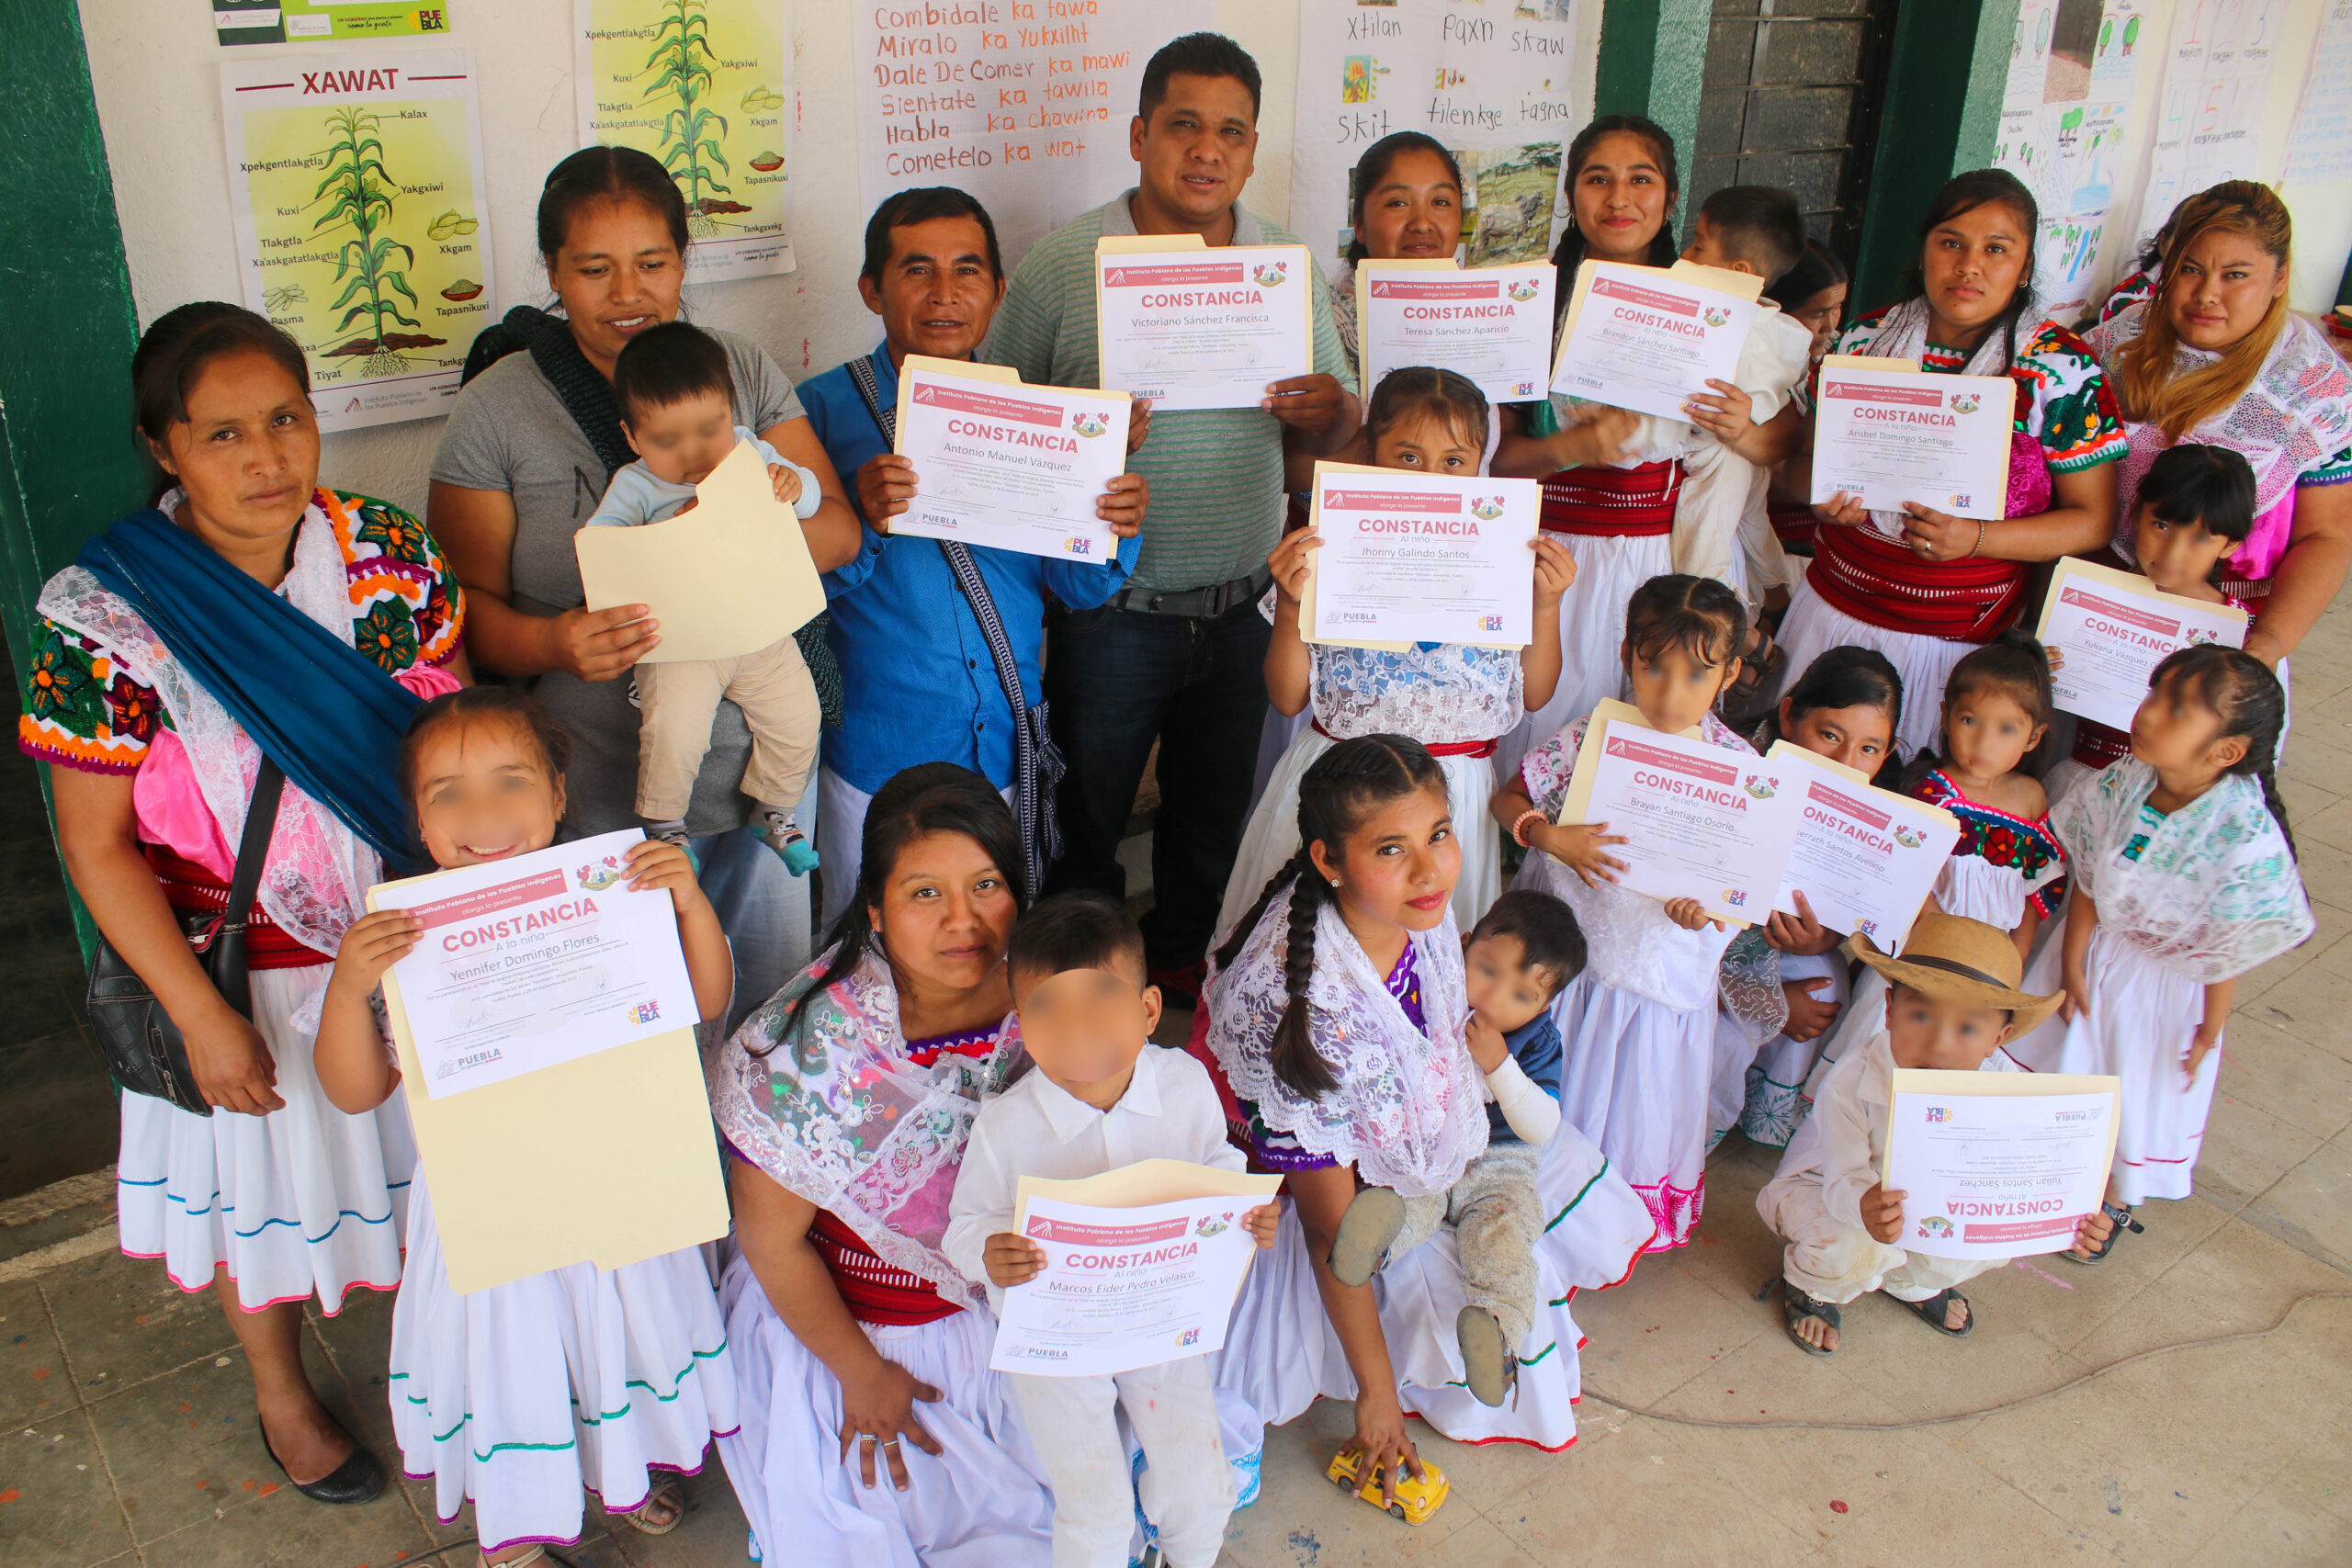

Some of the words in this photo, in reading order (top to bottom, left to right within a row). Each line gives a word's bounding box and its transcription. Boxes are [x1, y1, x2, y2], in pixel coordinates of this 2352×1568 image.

[419, 10, 441, 19] PUE
[876, 1, 1000, 29] Combidale
[1012, 2, 1035, 20] ka
[422, 19, 443, 29] BLA
[2184, 1, 2202, 45] 1
[585, 28, 655, 40] Xpekgentlakgtla
[877, 33, 956, 58] Miralo
[982, 30, 1008, 51] ka
[720, 59, 758, 70] Yakgxiwi
[613, 73, 632, 83] Kuxi
[874, 61, 926, 87] Dale
[934, 61, 964, 83] De
[970, 60, 1035, 81] Comer
[1048, 57, 1073, 77] ka
[302, 68, 399, 95] XAWAT
[882, 89, 977, 116] Sientate
[1000, 88, 1028, 108] ka
[1044, 79, 1108, 102] tawila
[400, 110, 427, 119] Kalax
[598, 102, 633, 114] Tlakgtla
[2202, 85, 2224, 131] 5
[750, 118, 777, 127] Xkgam
[887, 115, 950, 145] Habla
[987, 113, 1016, 133] ka
[240, 157, 323, 173] Xpekgentlakgtla
[887, 146, 992, 176] Cometelo
[1004, 142, 1031, 164] ka
[744, 174, 788, 186] Tapasnikuxi
[401, 182, 444, 196] Yakgxiwi
[277, 206, 300, 216] Kuxi
[261, 237, 302, 248] Tlakgtla
[439, 243, 472, 254] Xkgam
[1141, 290, 1263, 308] CONSTANCIA
[435, 301, 489, 317] Tapasnikuxi
[1404, 305, 1515, 320] CONSTANCIA
[1132, 317, 1181, 328] Victoriano
[1183, 315, 1223, 325] Sánchez
[1614, 307, 1704, 338] CONSTANCIA
[1405, 327, 1432, 336] Teresa
[1474, 324, 1510, 334] Aparicio
[1602, 328, 1634, 342] Brandon
[1668, 344, 1700, 359] Santiago
[438, 357, 467, 367] Tankga
[314, 370, 342, 381] Tiyat
[1853, 407, 1956, 426] CONSTANCIA
[948, 419, 1079, 454] CONSTANCIA
[1879, 432, 1916, 443] Domingo
[1918, 435, 1953, 446] Santiago
[944, 443, 985, 457] Antonio
[988, 449, 1027, 465] Manuel
[1838, 483, 1865, 491] PUEBLA
[922, 514, 956, 525] PUEBLA
[1359, 519, 1479, 536] CONSTANCIA
[1074, 538, 1091, 547] PUE
[1072, 545, 1089, 555] BLA
[1362, 547, 1396, 558] Jhonny
[1398, 548, 1435, 558] Galindo
[1438, 550, 1470, 559] Santos
[1343, 613, 1376, 621] PUEBLA
[1487, 616, 1503, 625] PUE
[1487, 623, 1502, 631] BLA
[2085, 617, 2184, 653] CONSTANCI
[2085, 639, 2112, 654] Yuliana
[1634, 772, 1747, 811] CONSTANCIA
[1630, 796, 1661, 813] Brayan
[1664, 806, 1702, 824] Santiago
[1804, 807, 1894, 854] ONSTANCIA
[1826, 840, 1853, 858] Santos
[1855, 854, 1884, 872] Avelino
[415, 904, 446, 917] Instituto
[447, 896, 475, 908] Poblano
[477, 893, 486, 901] de
[487, 890, 497, 898] los
[499, 883, 526, 894] Pueblos
[443, 897, 599, 952] CONSTANCIA
[496, 942, 504, 952] A
[506, 938, 517, 949] la
[449, 960, 502, 982] Yennifer
[505, 944, 560, 967] Domingo
[563, 932, 600, 951] Flores
[638, 1001, 659, 1014] PUE
[639, 1010, 661, 1024] BLA
[458, 1048, 502, 1066] PUEBLA
[2003, 1178, 2033, 1188] Santos
[2036, 1177, 2062, 1185] Yulian
[1947, 1199, 2064, 1216] CONSTANCIA
[1056, 1224, 1085, 1233] Instituto
[1135, 1225, 1158, 1234] Pueblos
[1066, 1242, 1198, 1269] CONSTANCIA
[1049, 1281, 1092, 1293] Marcos
[1127, 1280, 1157, 1292] Pedro
[1160, 1270, 1194, 1285] Velasco
[1114, 1270, 1124, 1279] Al
[1028, 1347, 1069, 1358] PUEBLA
